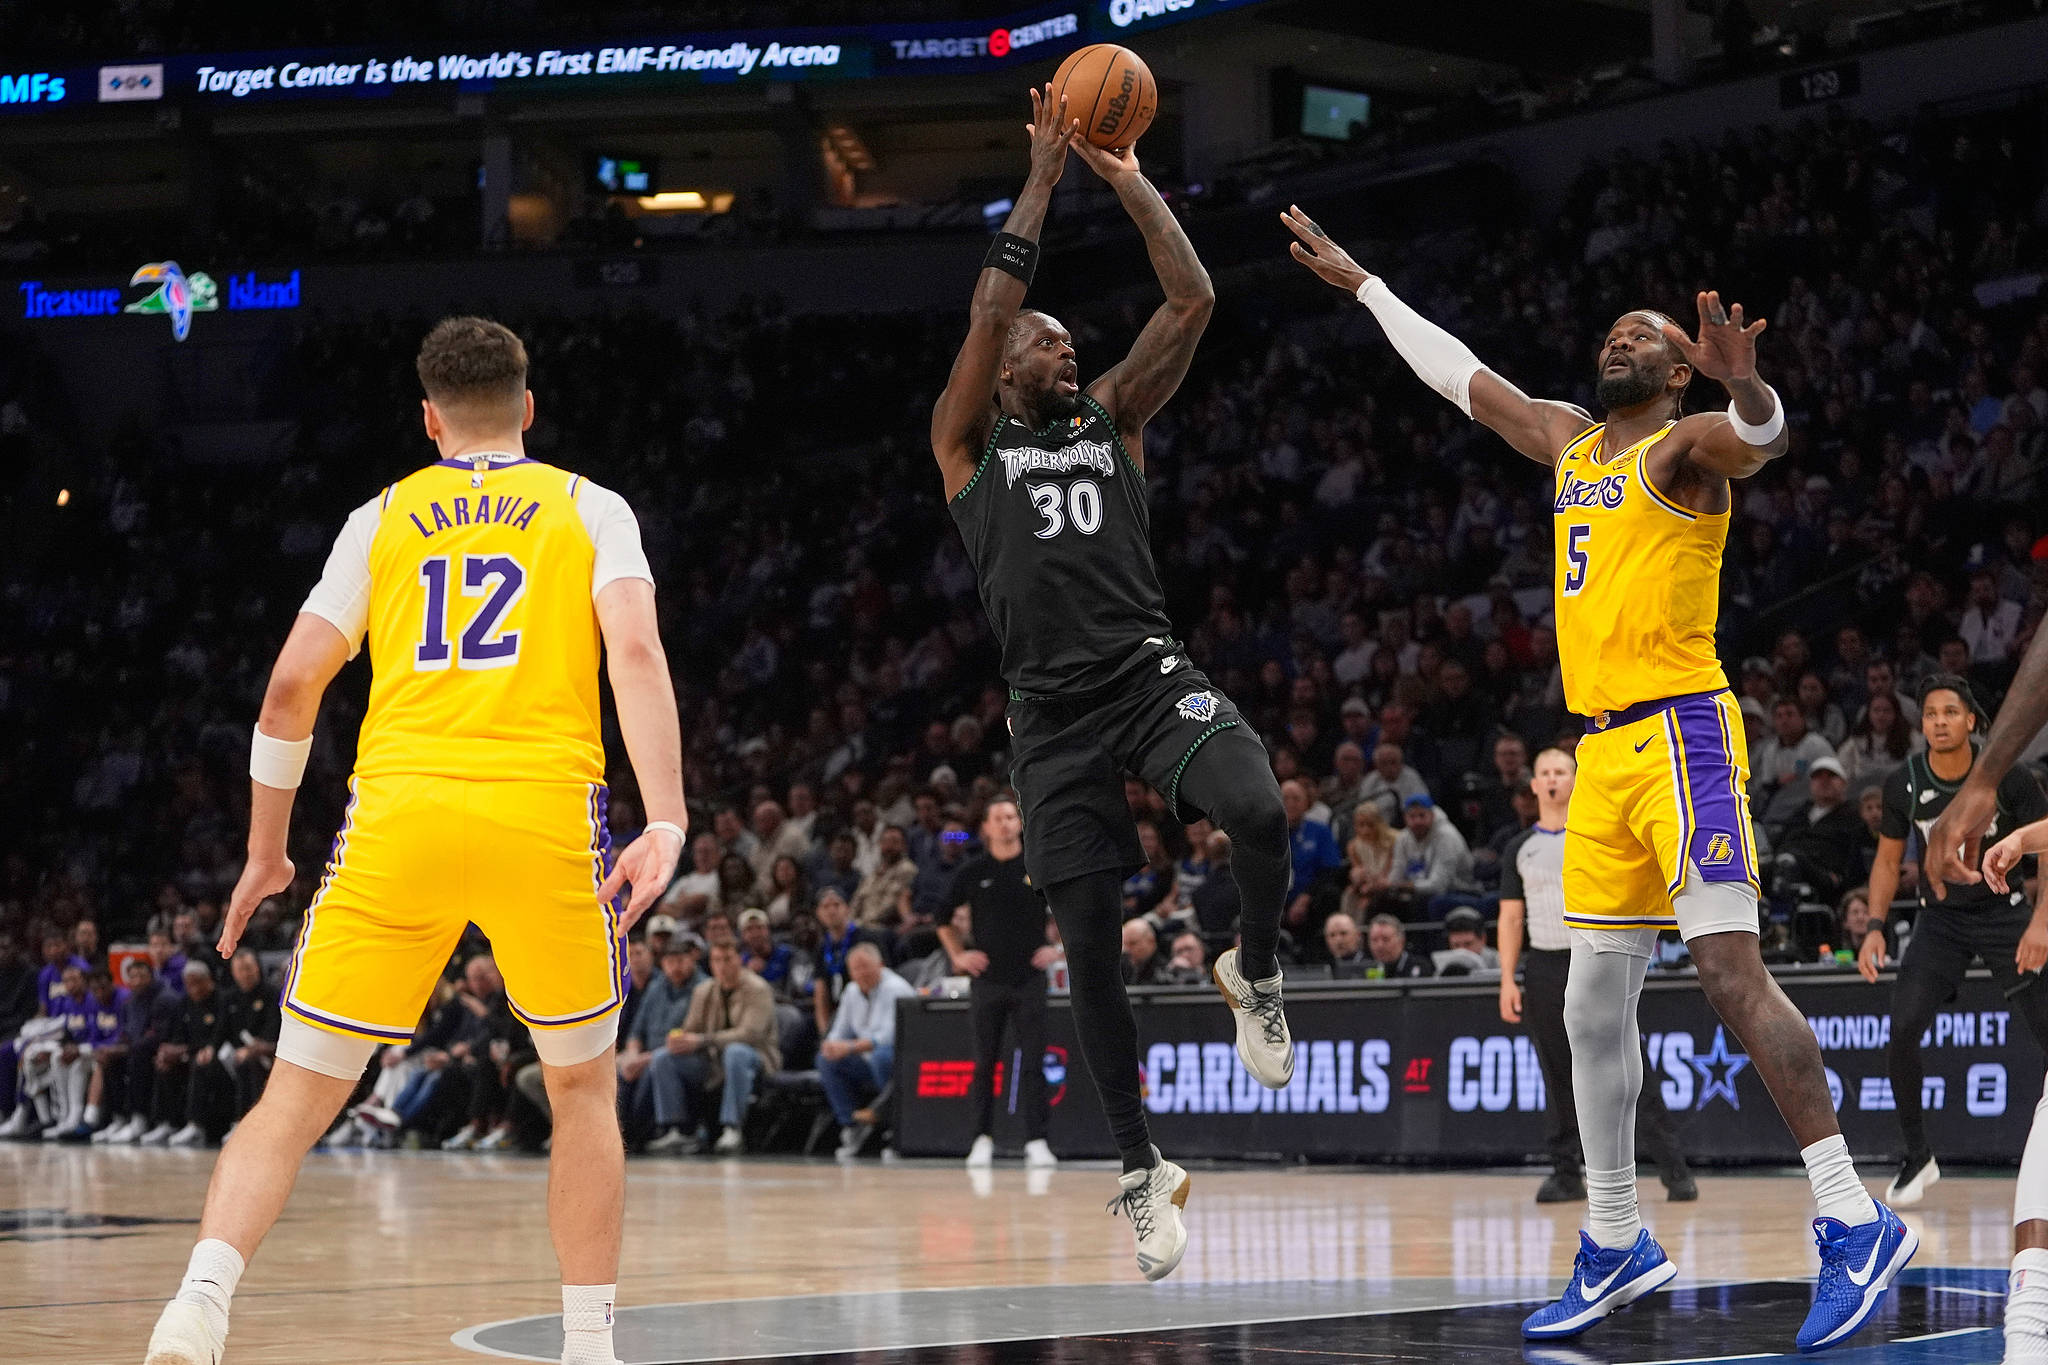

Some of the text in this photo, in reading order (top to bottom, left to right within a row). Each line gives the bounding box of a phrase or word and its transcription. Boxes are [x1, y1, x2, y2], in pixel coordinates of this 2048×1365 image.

[891, 13, 1078, 59] TARGET CENTER
[0, 73, 66, 104] MFs
[197, 42, 841, 97] Target Center is the World's First EMF-Friendly Arena
[1096, 69, 1135, 136] Wilson
[20, 269, 300, 317] Treasure Island
[1025, 479, 1103, 539] 30
[1554, 470, 1628, 514] LAKERS
[409, 495, 541, 538] LARAVIA
[1563, 524, 1591, 597] 5
[414, 554, 526, 671] 12
[1806, 1014, 1891, 1050] MONDA
[1936, 1012, 1976, 1048] PM
[1980, 1011, 2010, 1047] ET
[1404, 1058, 1431, 1081] AT
